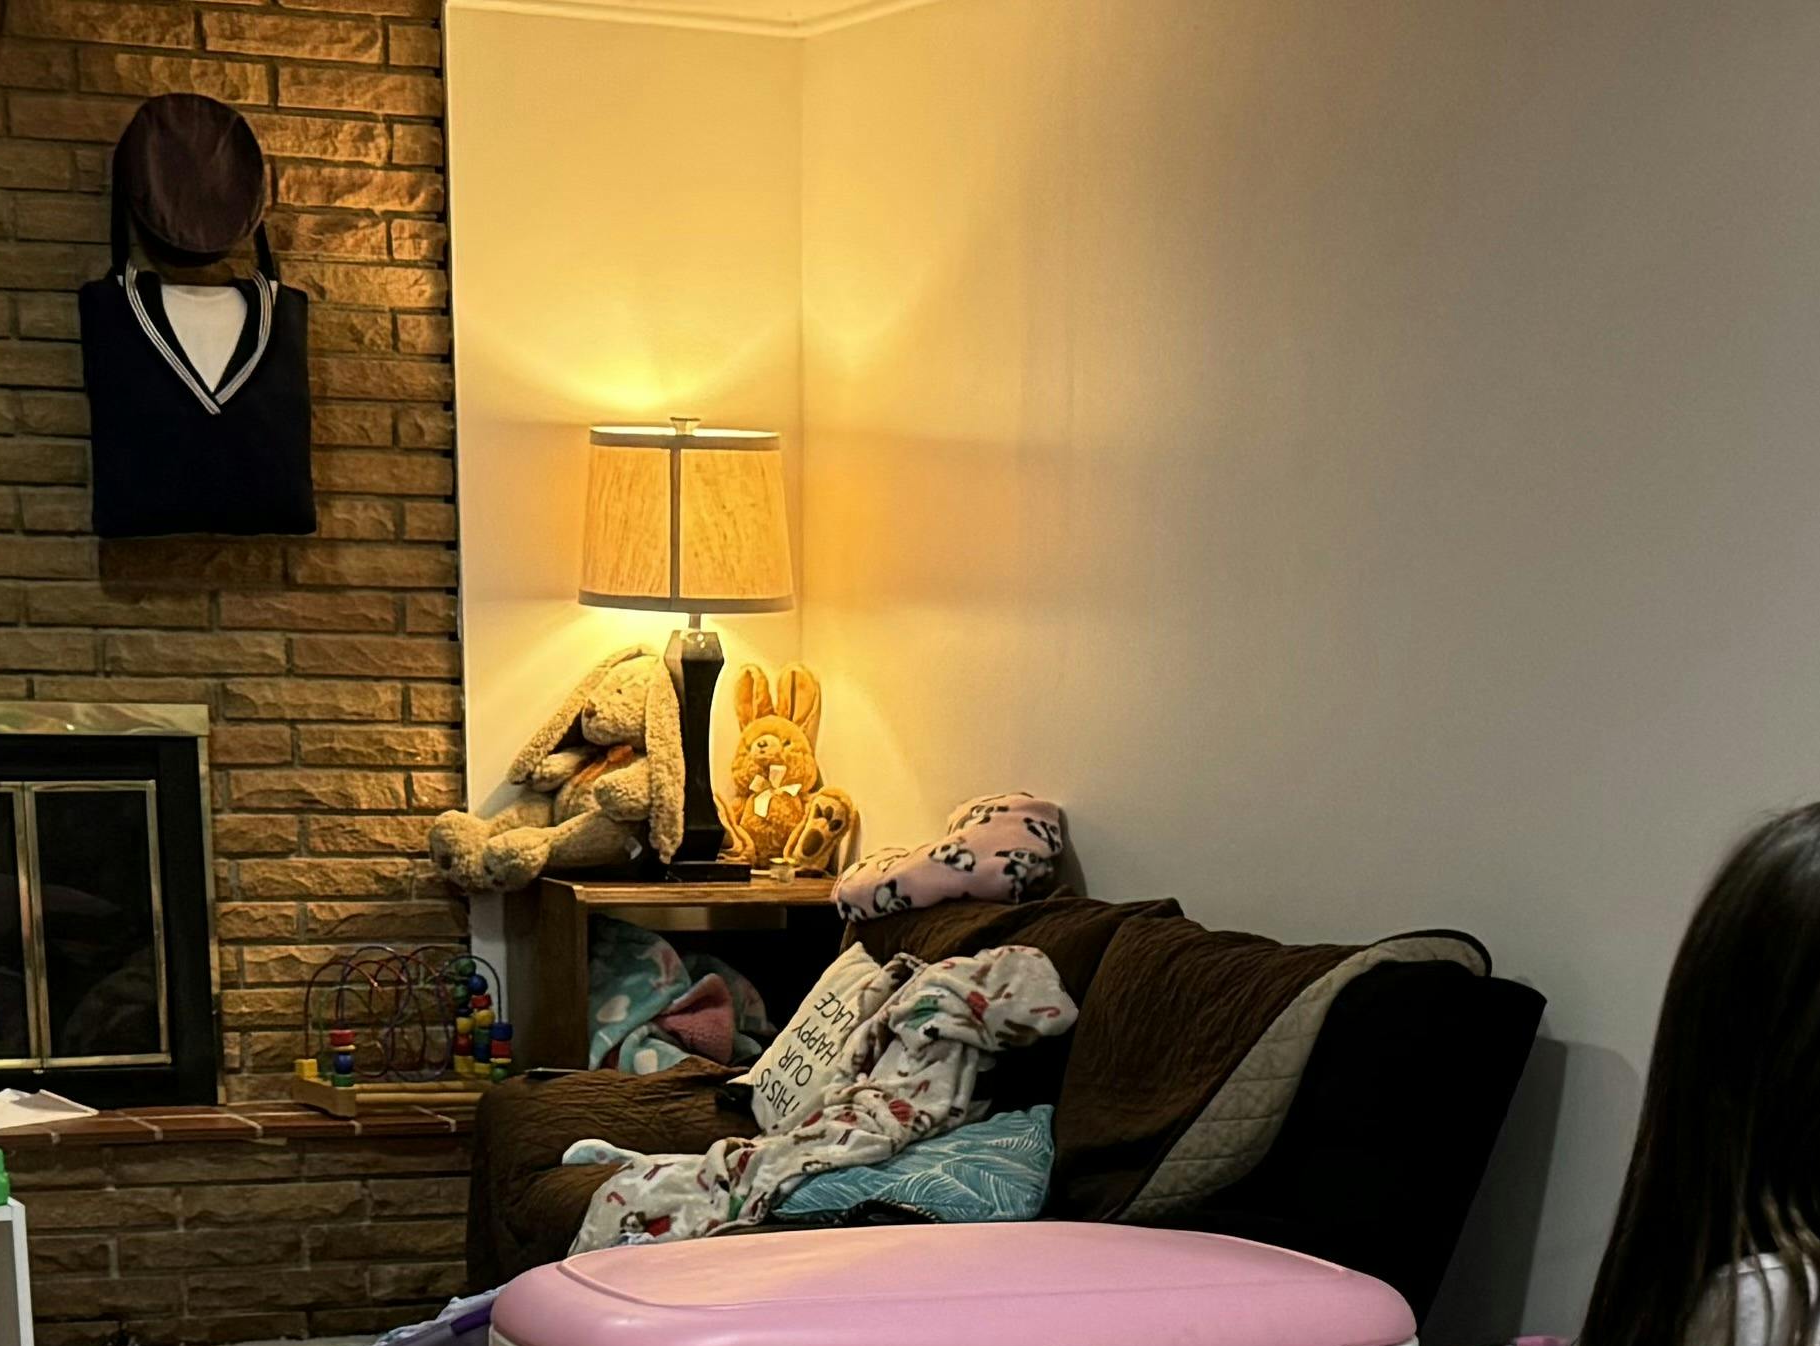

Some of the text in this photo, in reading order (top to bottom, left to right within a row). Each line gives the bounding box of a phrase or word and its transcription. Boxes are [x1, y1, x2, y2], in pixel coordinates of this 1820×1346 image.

[814, 991, 856, 1033] LACE
[791, 1016, 839, 1066] HAPPY
[755, 1068, 771, 1093] IS
[778, 1045, 813, 1087] OUR
